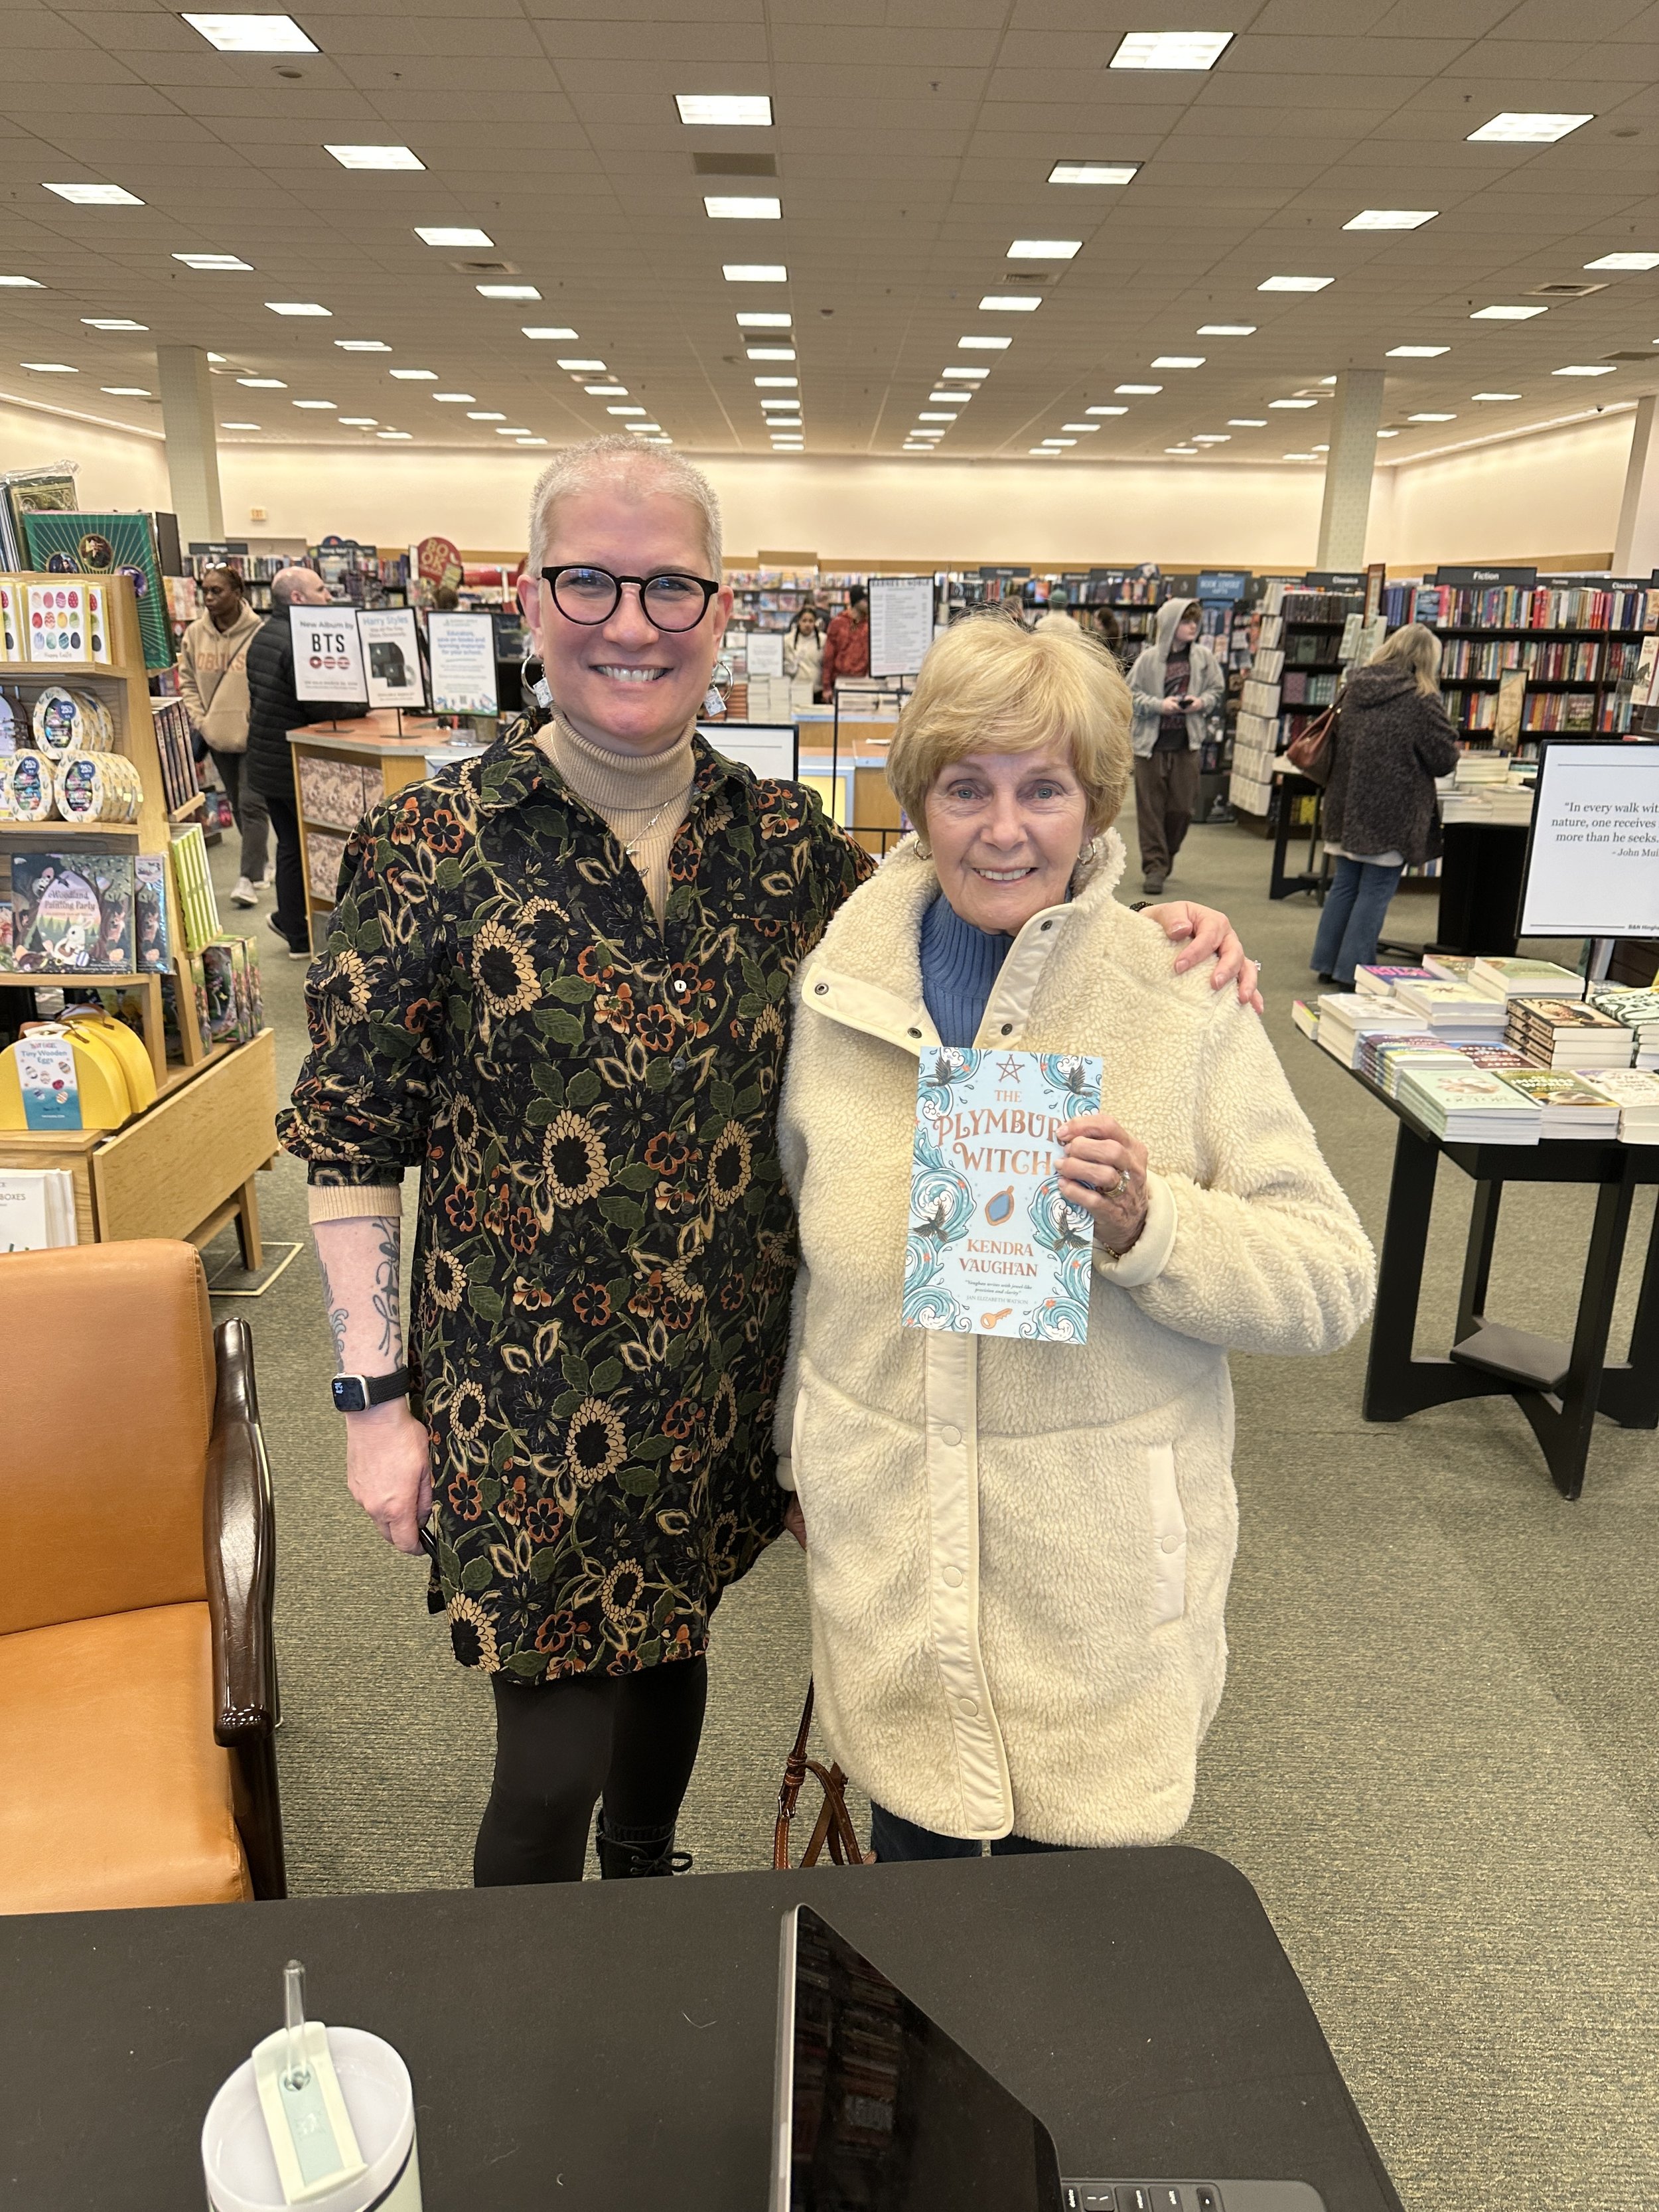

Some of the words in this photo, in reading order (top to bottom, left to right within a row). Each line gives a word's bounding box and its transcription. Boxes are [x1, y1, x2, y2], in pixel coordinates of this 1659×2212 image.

[1332, 575, 1359, 585] Classics
[1473, 571, 1500, 581] Fiction
[1612, 581, 1638, 590] Classics
[345, 622, 354, 630] by
[363, 617, 385, 626] Harry
[386, 616, 409, 625] Styles
[312, 633, 345, 653] BTS
[1583, 805, 1612, 815] every
[1615, 802, 1639, 813] walk
[1642, 804, 1659, 813] wit
[1551, 818, 1589, 828] nature,
[1614, 818, 1656, 828] receives
[1555, 833, 1583, 842] more
[1586, 832, 1610, 842] than
[1613, 832, 1625, 843] he
[1617, 849, 1639, 857] John
[1641, 849, 1659, 857] Mui
[48, 890, 90, 899] Woodland
[44, 900, 74, 911] Painting
[76, 901, 96, 911] Party
[995, 1090, 1023, 1103] THE
[932, 1108, 1067, 1147] PLYMBUR
[953, 1142, 1054, 1176] WITCH
[967, 1238, 1035, 1257] KENDRA
[959, 1258, 1039, 1278] VAUGHAN
[1169, 2190, 1177, 2205] shift
